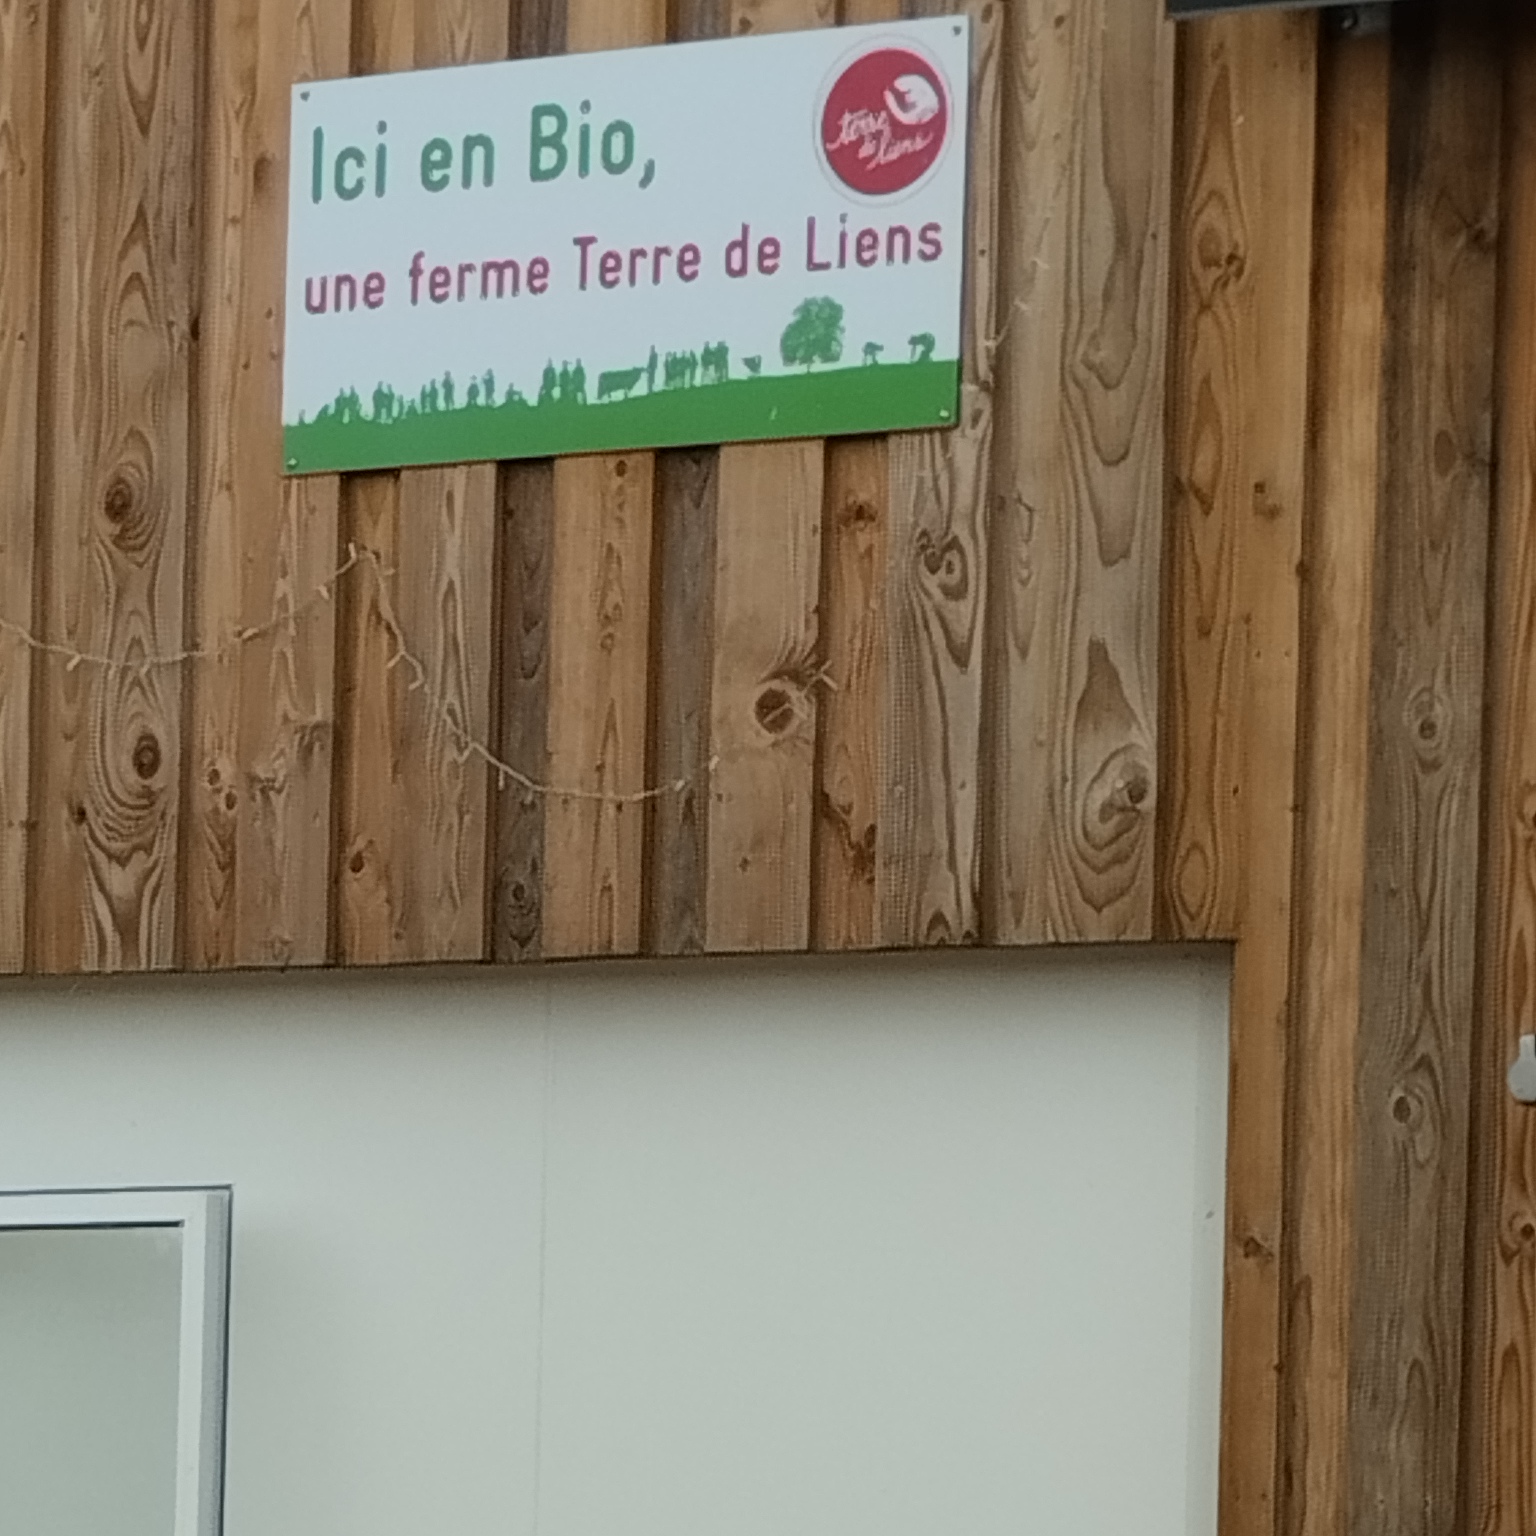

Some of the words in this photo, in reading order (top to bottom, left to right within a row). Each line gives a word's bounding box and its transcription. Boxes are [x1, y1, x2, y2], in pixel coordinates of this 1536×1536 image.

[311, 119, 388, 205] Ici
[420, 132, 495, 193] en
[528, 98, 656, 190] Bio,
[304, 271, 386, 315] une
[408, 249, 551, 306] ferme
[572, 235, 702, 292] Terre
[724, 221, 782, 279] de
[805, 212, 944, 272] Liens
